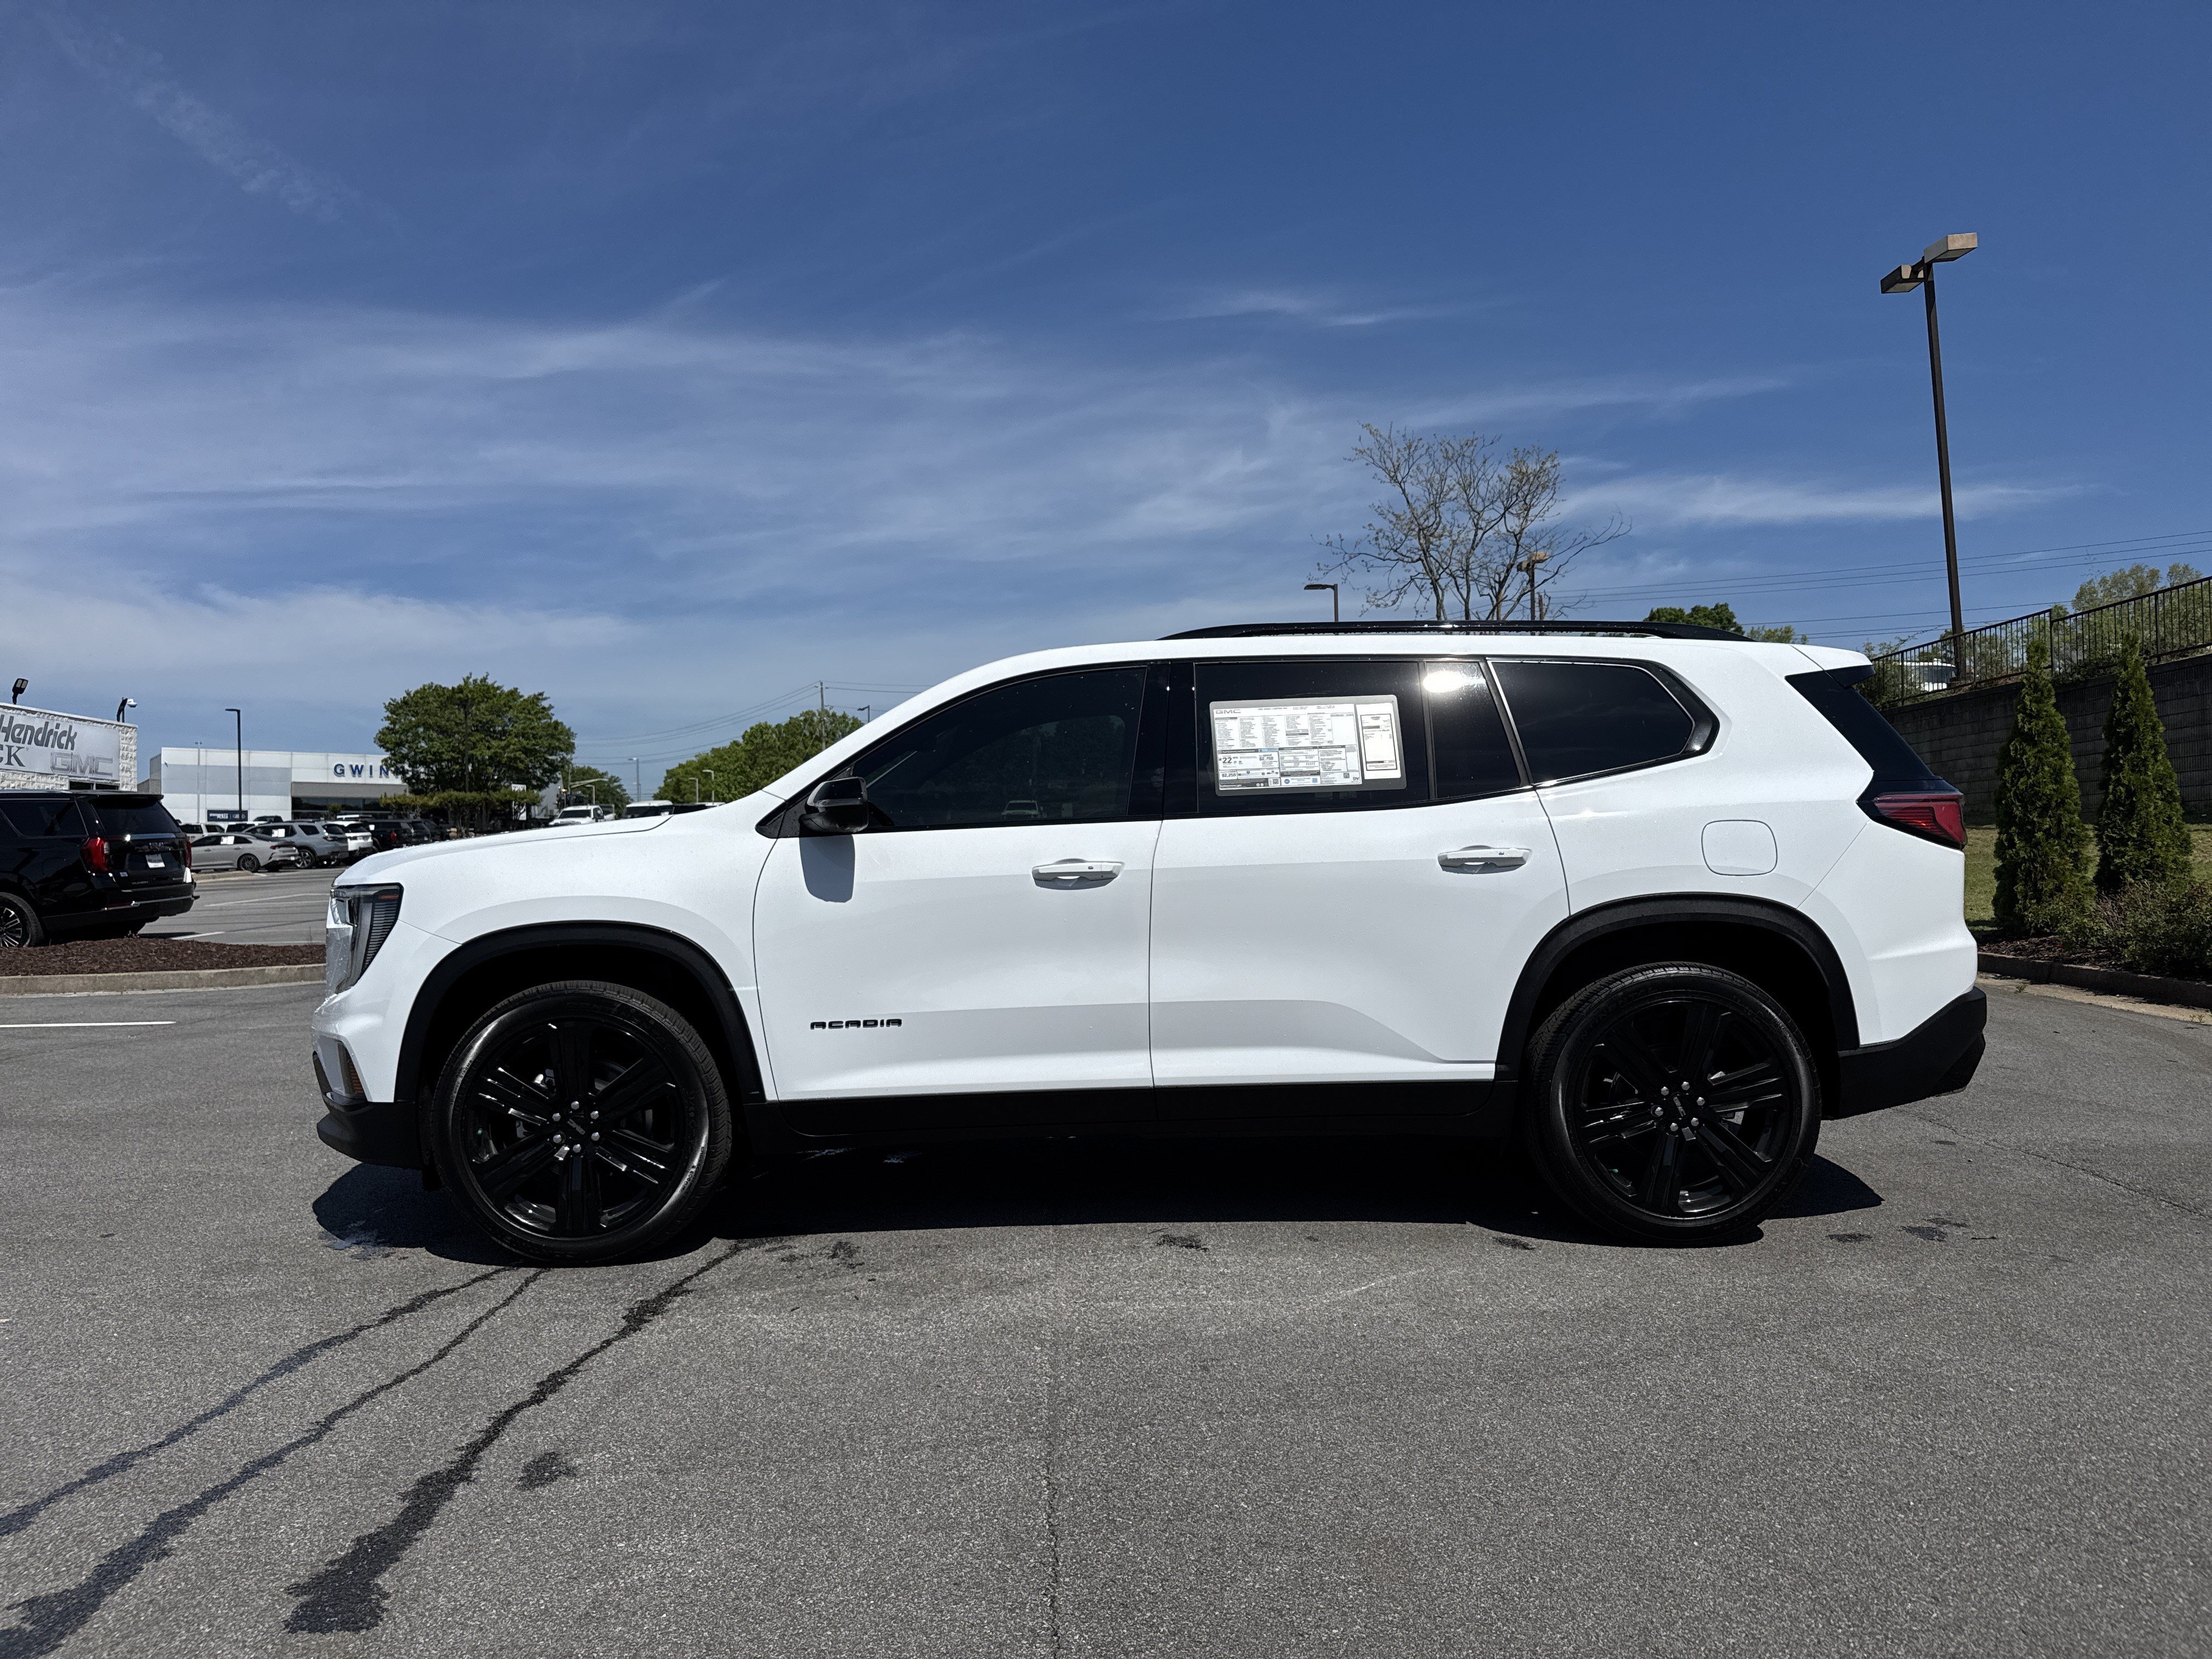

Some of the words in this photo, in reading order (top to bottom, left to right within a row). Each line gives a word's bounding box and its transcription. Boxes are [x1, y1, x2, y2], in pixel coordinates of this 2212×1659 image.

[0, 714, 77, 751] Hendrick
[0, 744, 26, 768] K
[50, 751, 113, 777] GMC
[810, 1019, 902, 1030] ACADIA
